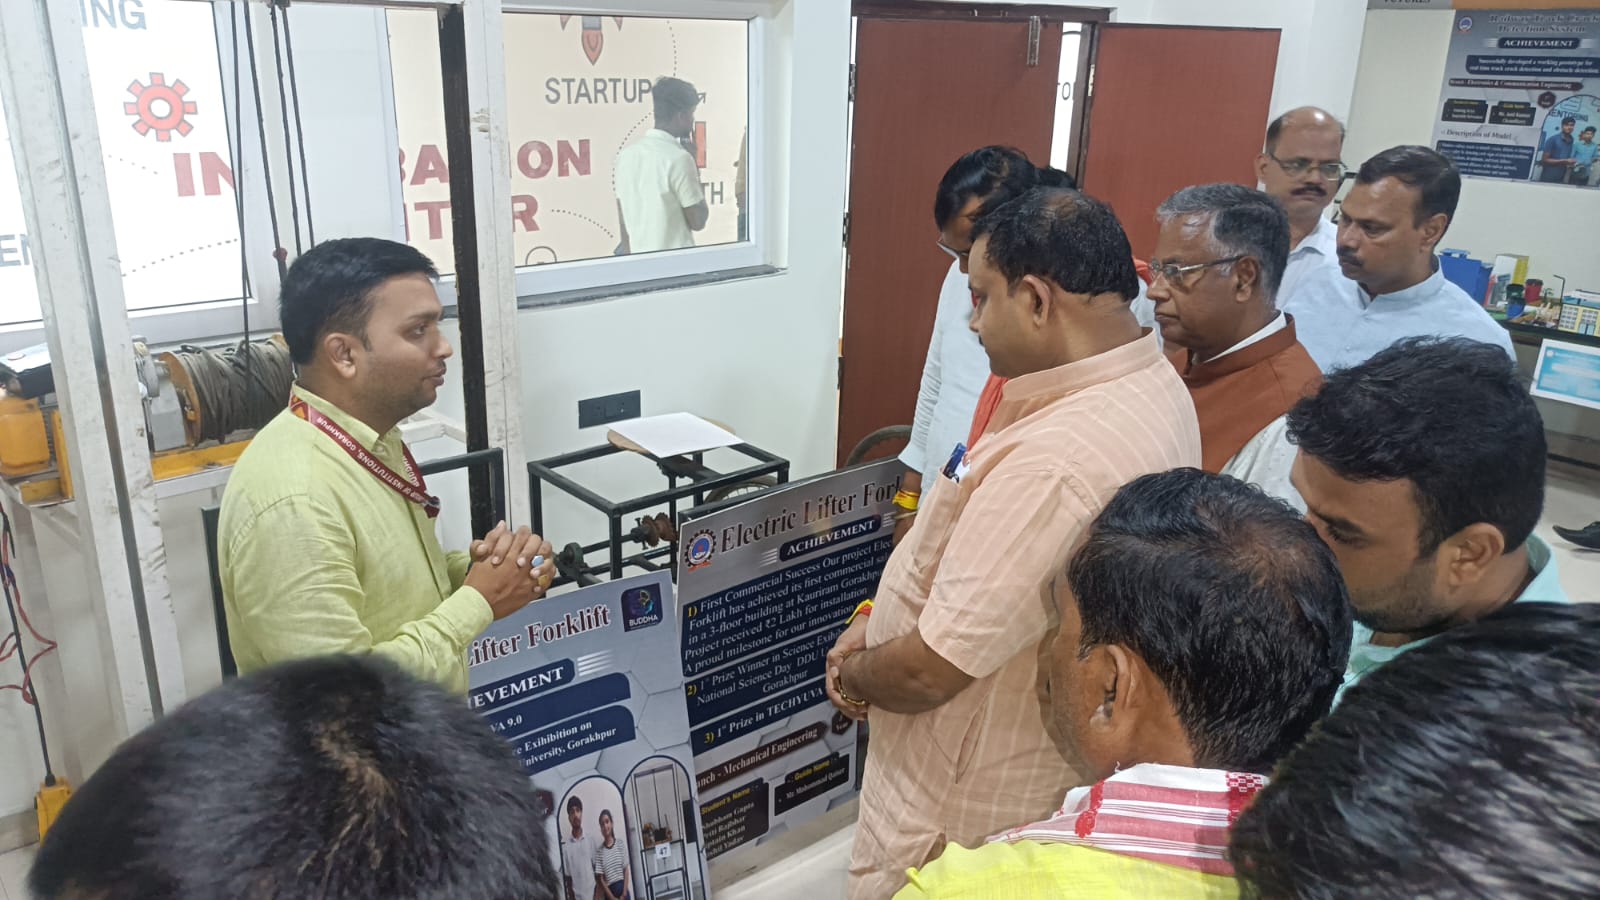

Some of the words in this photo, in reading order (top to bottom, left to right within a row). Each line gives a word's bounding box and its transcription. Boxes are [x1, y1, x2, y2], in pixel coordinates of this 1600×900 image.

[316, 416, 357, 451] GORAKHPUR
[720, 508, 797, 553] Electric
[803, 492, 857, 526] Lifter
[786, 519, 876, 556] ACHIEVEMENT
[687, 605, 698, 618] 1)
[700, 597, 722, 613] First
[724, 573, 783, 603] Commercial
[785, 563, 821, 580] Success
[822, 556, 840, 569] Our
[841, 544, 872, 565] project
[689, 607, 727, 631] Forklift
[728, 599, 745, 616] has
[747, 587, 789, 610] achieved
[790, 582, 802, 593] its
[804, 574, 822, 589] first
[823, 557, 874, 584] commercial
[525, 605, 612, 649] Forklift
[628, 614, 659, 627] BUDDHA
[684, 641, 719, 661] Project
[721, 624, 763, 643] received
[779, 611, 802, 626] Lakh
[804, 603, 818, 616] for
[819, 587, 867, 613] installation
[688, 635, 698, 646] in
[700, 631, 707, 641] a
[708, 618, 743, 638] 3-floor
[744, 601, 784, 623] building
[784, 600, 795, 609] at
[797, 583, 839, 604] Kauriram
[684, 664, 693, 674] A
[694, 651, 724, 673] proud
[726, 635, 773, 659] milestone
[775, 626, 790, 640] for
[790, 622, 806, 634] our
[687, 684, 697, 697] 2)
[711, 671, 736, 686] Prize
[737, 657, 770, 675] Winner
[771, 653, 781, 663] in
[782, 641, 816, 659] Science
[697, 681, 736, 706] National
[738, 671, 772, 690] Science
[774, 664, 792, 677] Day
[796, 650, 819, 667] DDU
[762, 669, 809, 694] Gorakhpur
[506, 714, 523, 728] 9.0
[524, 727, 578, 752] Exihibition
[580, 721, 593, 731] on
[567, 727, 617, 751] Gorakhpur
[704, 732, 715, 744] 3)
[728, 716, 753, 733] Prize
[755, 711, 765, 722] in
[766, 687, 824, 717] TECHYUVA
[723, 748, 770, 777] Mechanical
[771, 727, 819, 755] Engineering
